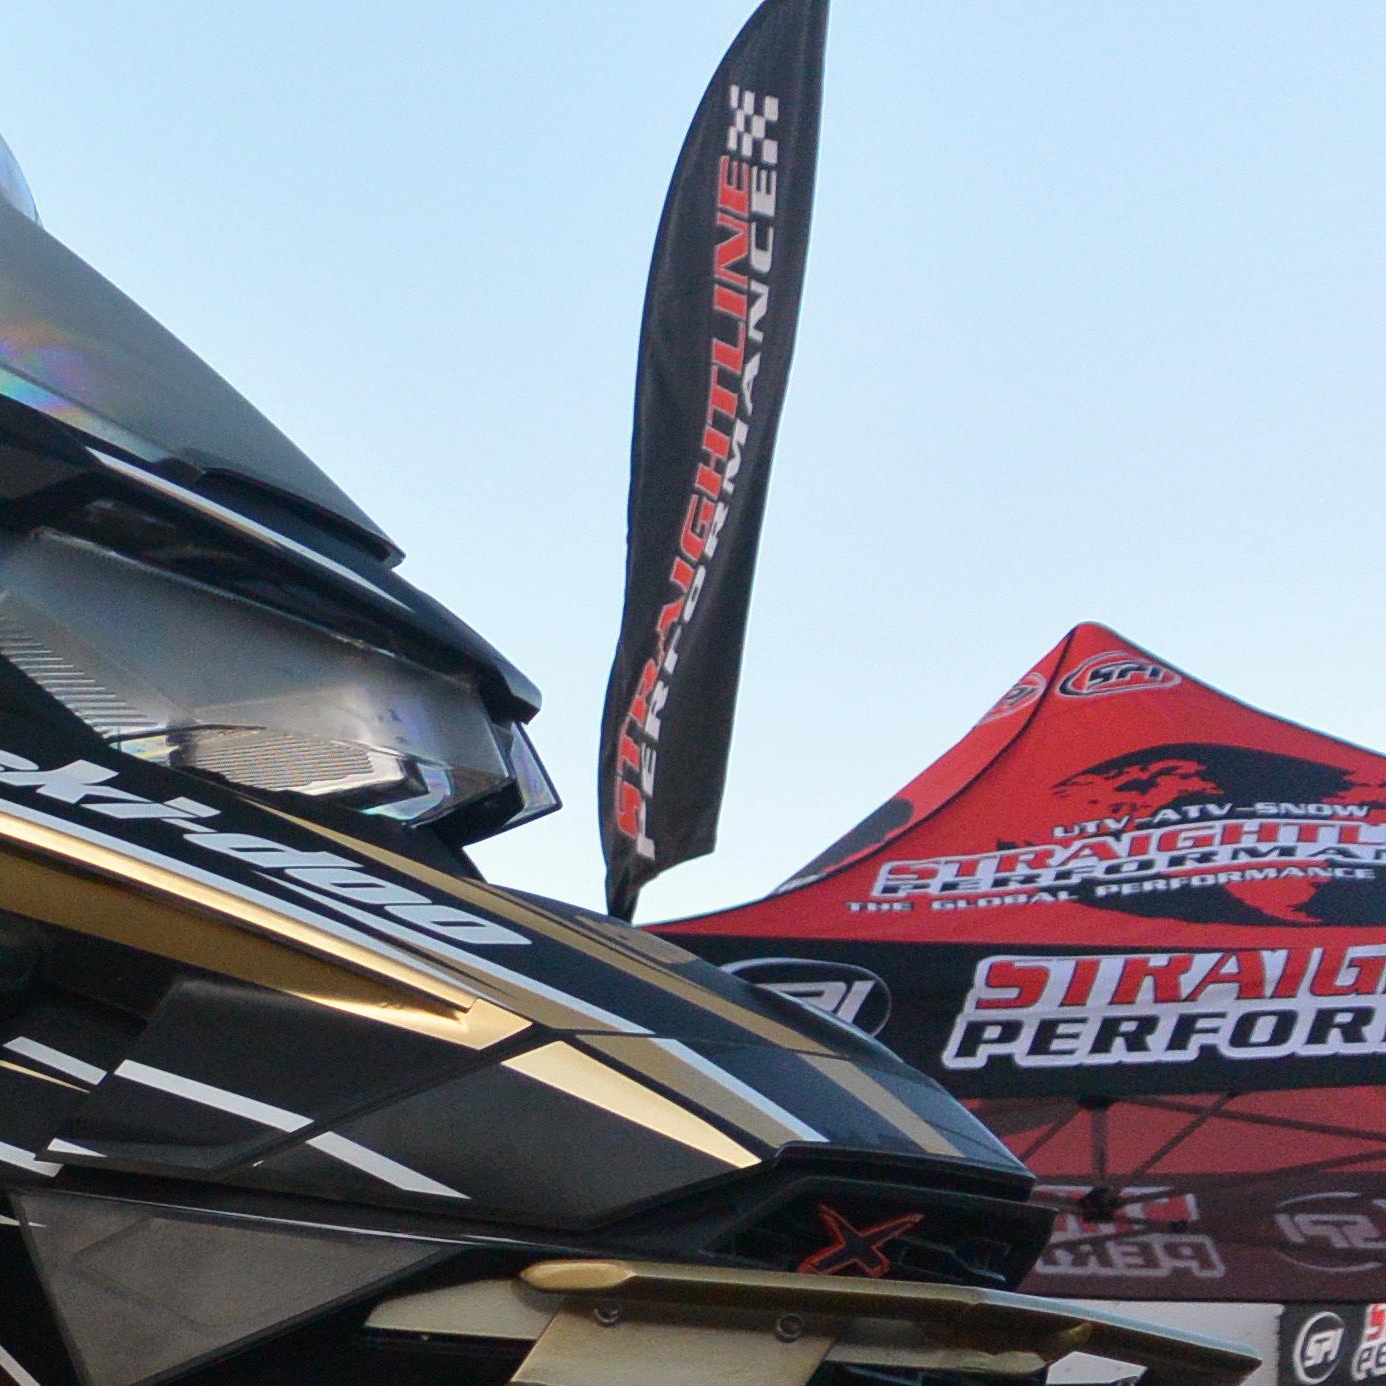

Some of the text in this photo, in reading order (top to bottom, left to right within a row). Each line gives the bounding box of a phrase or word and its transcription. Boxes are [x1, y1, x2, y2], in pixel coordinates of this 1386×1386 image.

[613, 155, 749, 839] STRAIGHTLINE
[636, 164, 778, 861] PERFORMANCE
[846, 865, 1376, 912] THE GLOBAL PERFORMANCE
